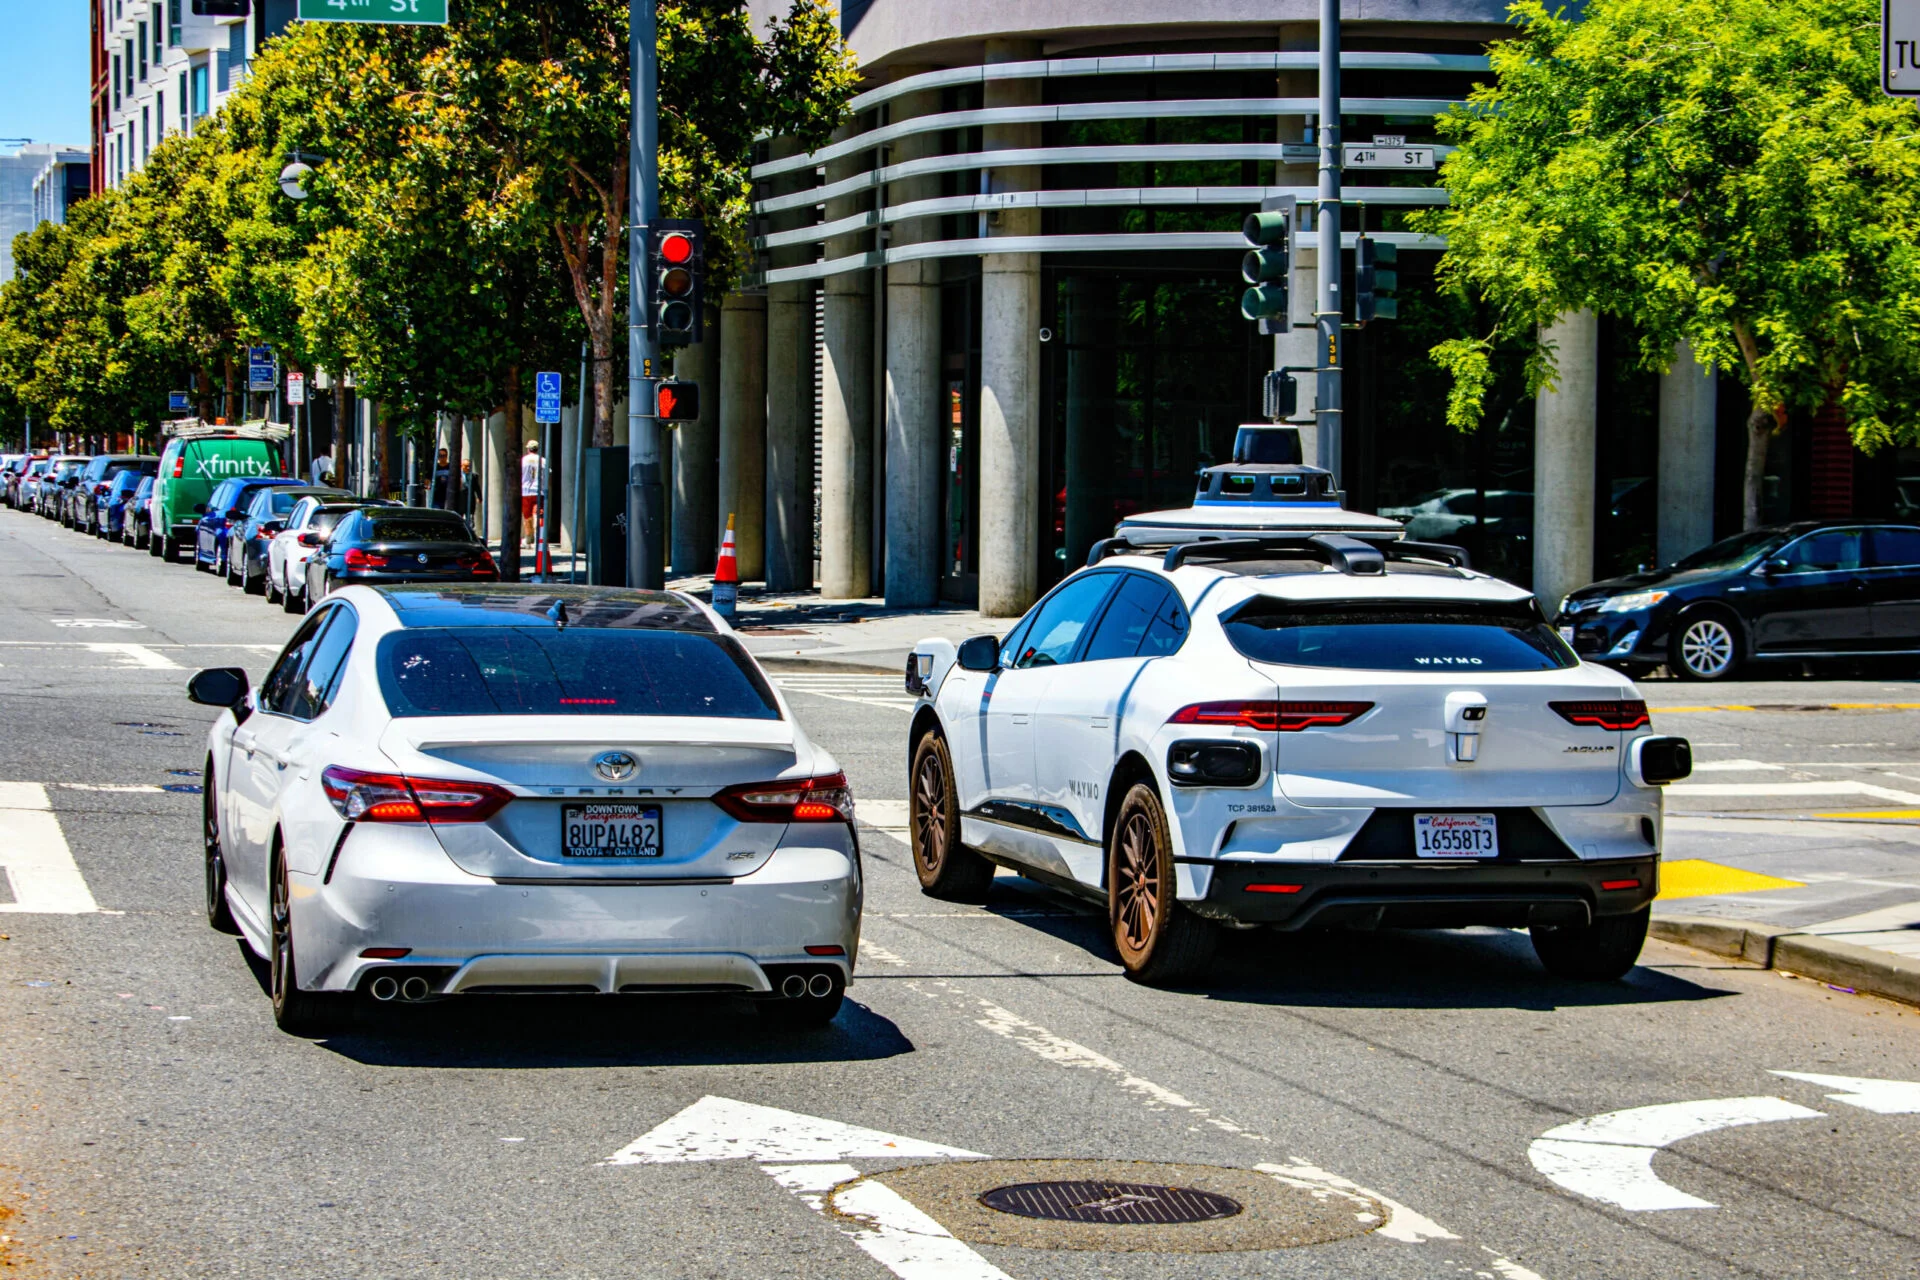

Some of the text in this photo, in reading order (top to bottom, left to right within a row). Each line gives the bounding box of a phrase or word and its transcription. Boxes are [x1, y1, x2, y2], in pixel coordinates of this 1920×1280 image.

[1354, 151, 1423, 164] 4TH ST
[537, 392, 560, 400] PARKING
[541, 400, 555, 408] ONLY
[196, 453, 270, 479] xfinity
[1414, 656, 1483, 665] WAYMO
[1562, 745, 1615, 753] JAGUAR
[549, 787, 683, 796] CAMRY
[1069, 779, 1099, 800] WAYMO
[586, 805, 639, 813] DOWNTOWN
[1227, 804, 1245, 813] TCP
[1431, 816, 1481, 830] California
[569, 823, 656, 848] 8UPA482
[1421, 829, 1493, 850] 16558T3
[569, 847, 604, 856] TOYOTA
[614, 847, 657, 856] OAKLAND
